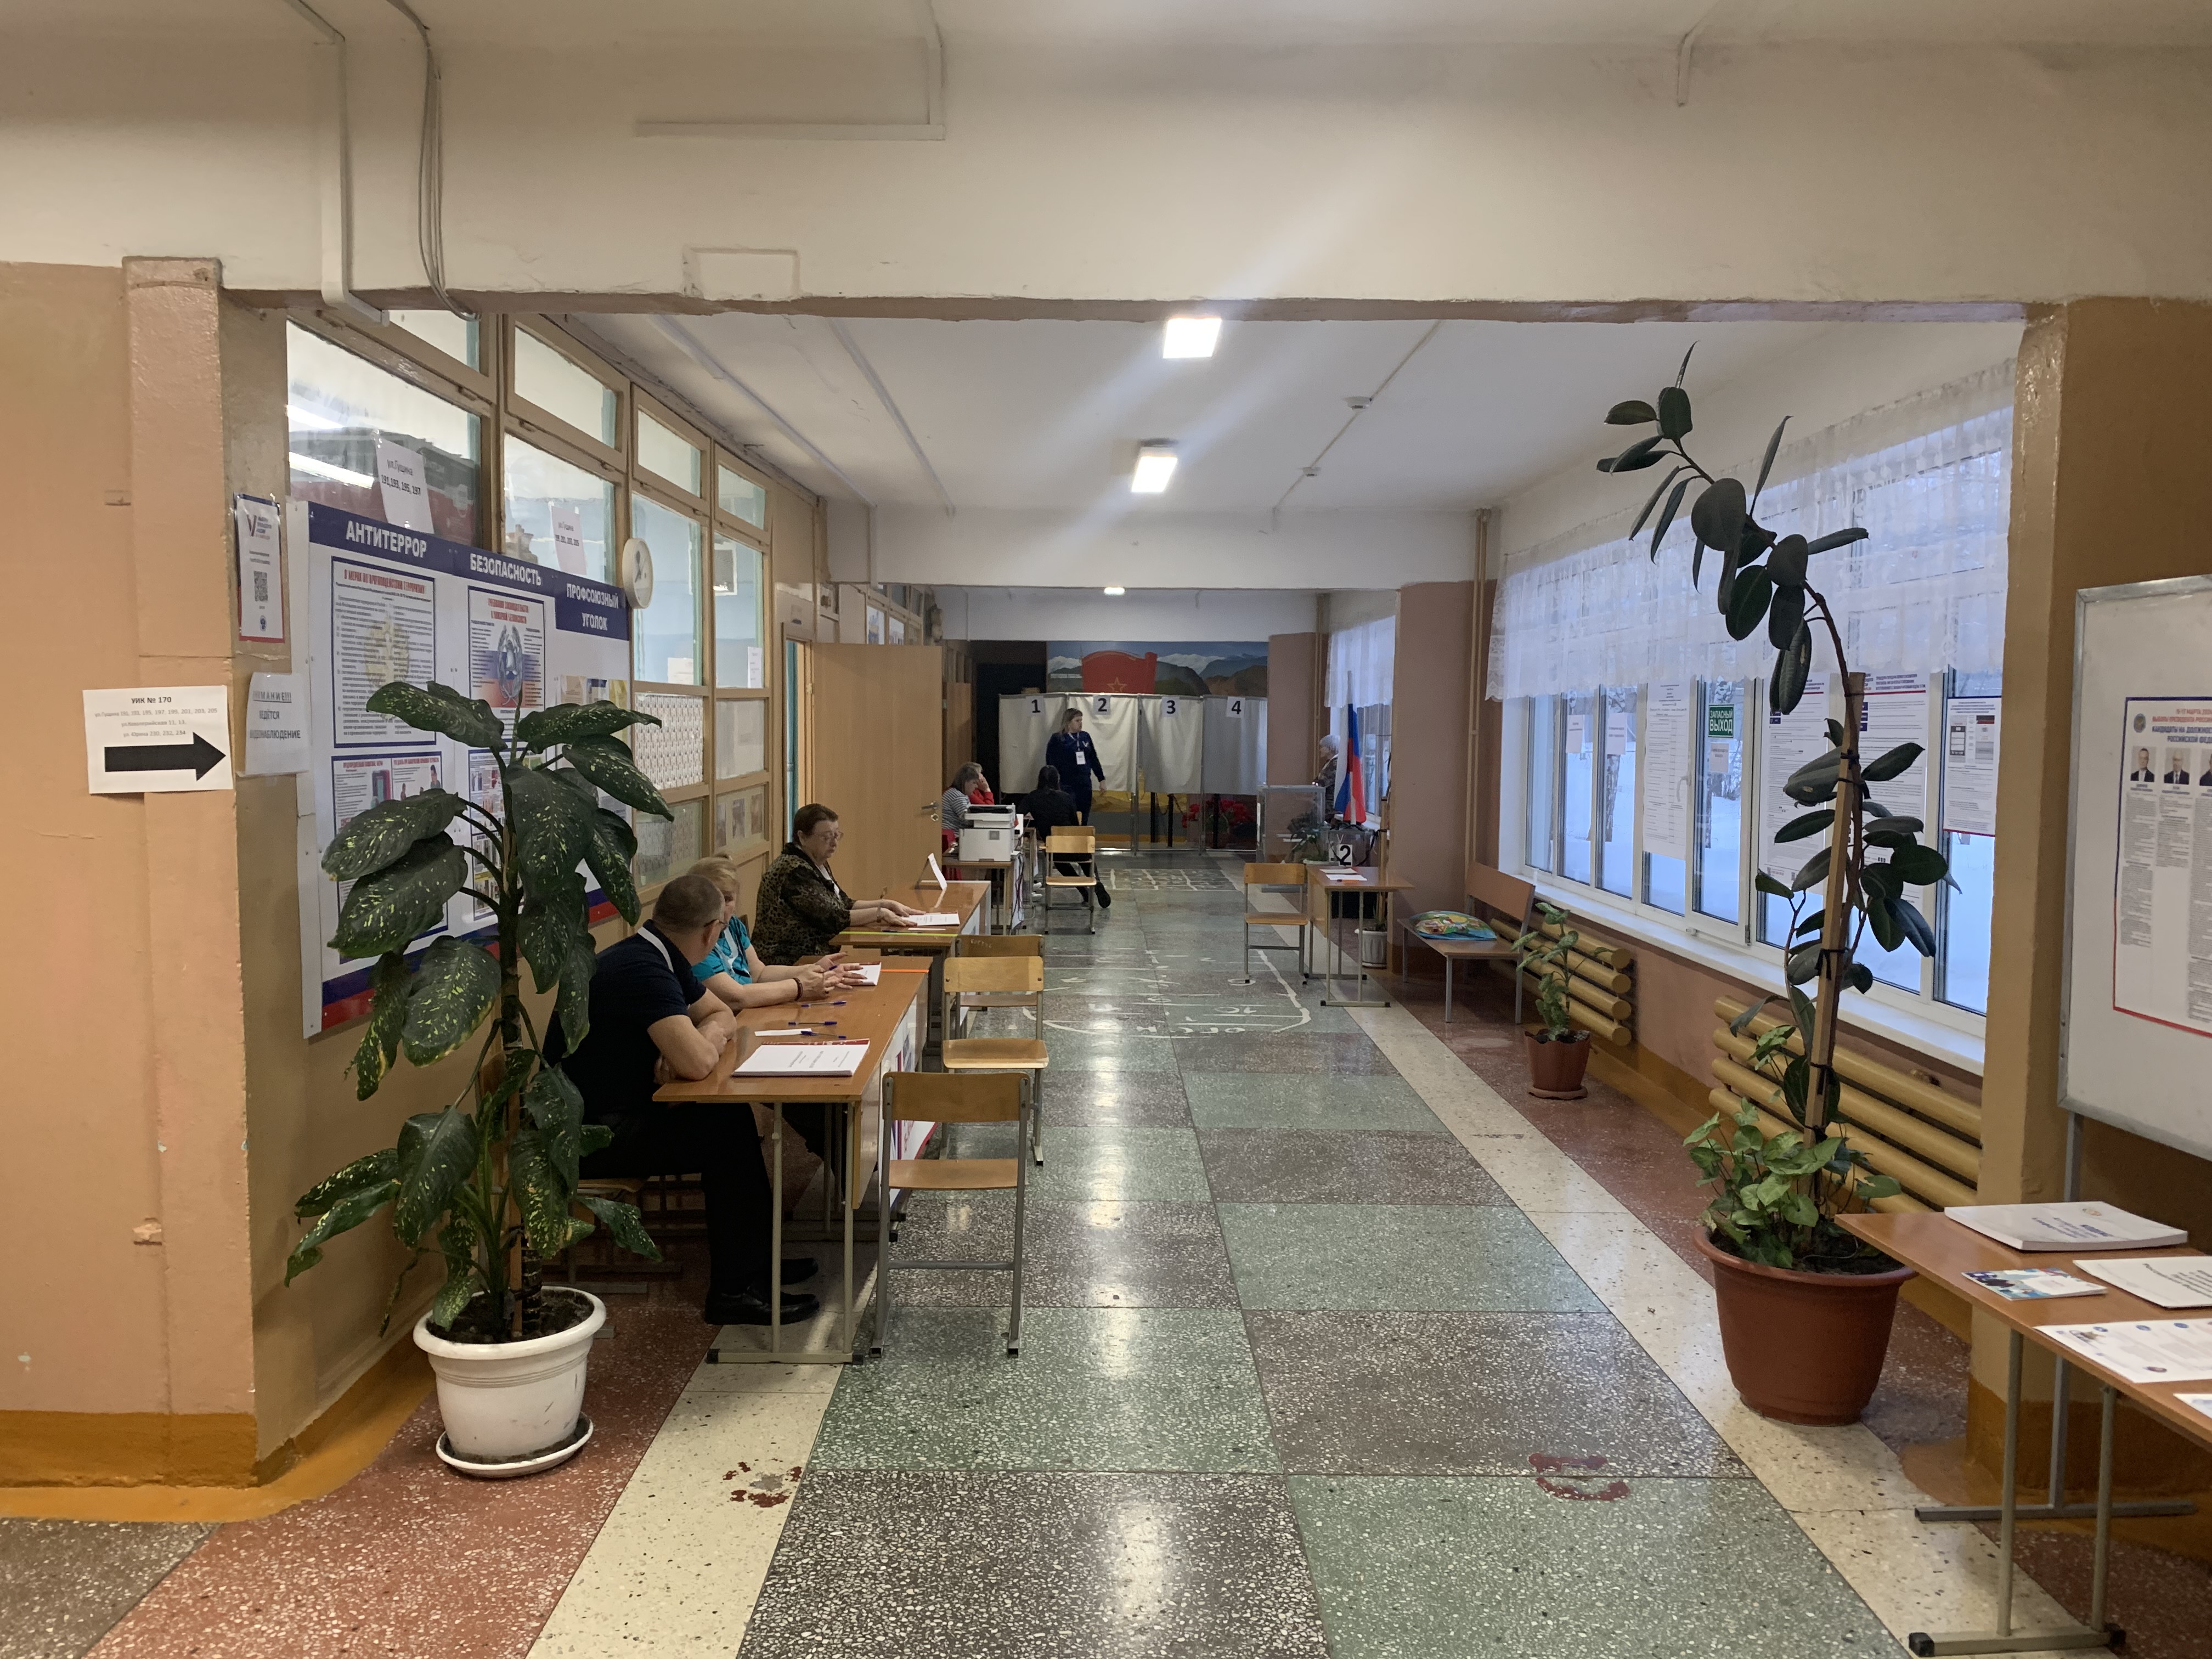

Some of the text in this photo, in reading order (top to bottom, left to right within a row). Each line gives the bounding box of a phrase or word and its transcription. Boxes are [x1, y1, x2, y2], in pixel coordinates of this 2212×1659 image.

[346, 520, 427, 558] АНТИТЕРРОР
[470, 553, 541, 586] БЕЗОПАСНОСТЬ
[566, 583, 619, 609] ПРОФСОЮЗНЫЙ
[582, 612, 608, 631] УГОЛОК
[1031, 699, 1041, 713] 1
[1098, 698, 1107, 712] 2
[1166, 700, 1176, 714] 3
[1231, 701, 1242, 714] 4
[1710, 709, 1733, 719] ЗАПАСНЫЙ
[1709, 719, 1733, 734] ВЫХОД
[1340, 845, 1351, 865] 2
